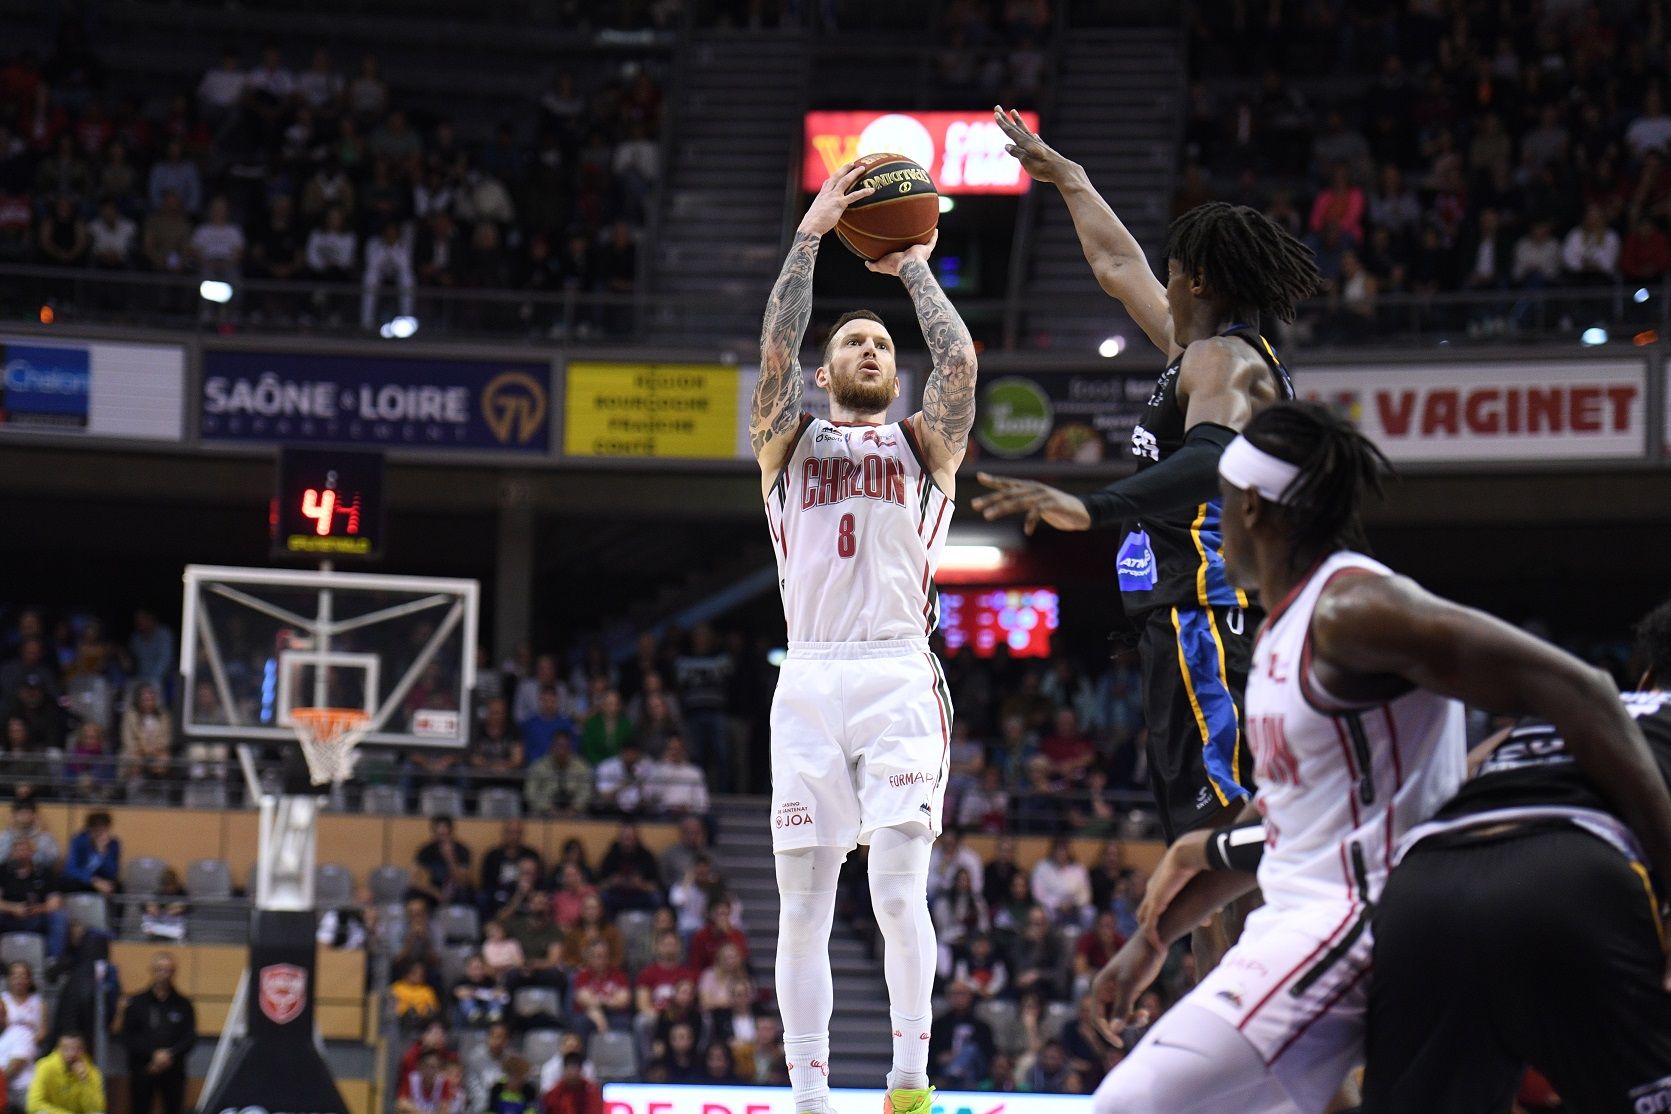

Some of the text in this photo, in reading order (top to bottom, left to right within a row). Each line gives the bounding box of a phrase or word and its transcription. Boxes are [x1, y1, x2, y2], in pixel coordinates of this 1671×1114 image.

[863, 168, 930, 190] SPALDING
[204, 371, 468, 422] SAÔNE LOIRE
[1375, 386, 1638, 438] VAGINET
[838, 513, 856, 558] 8
[785, 813, 813, 827] JOA
